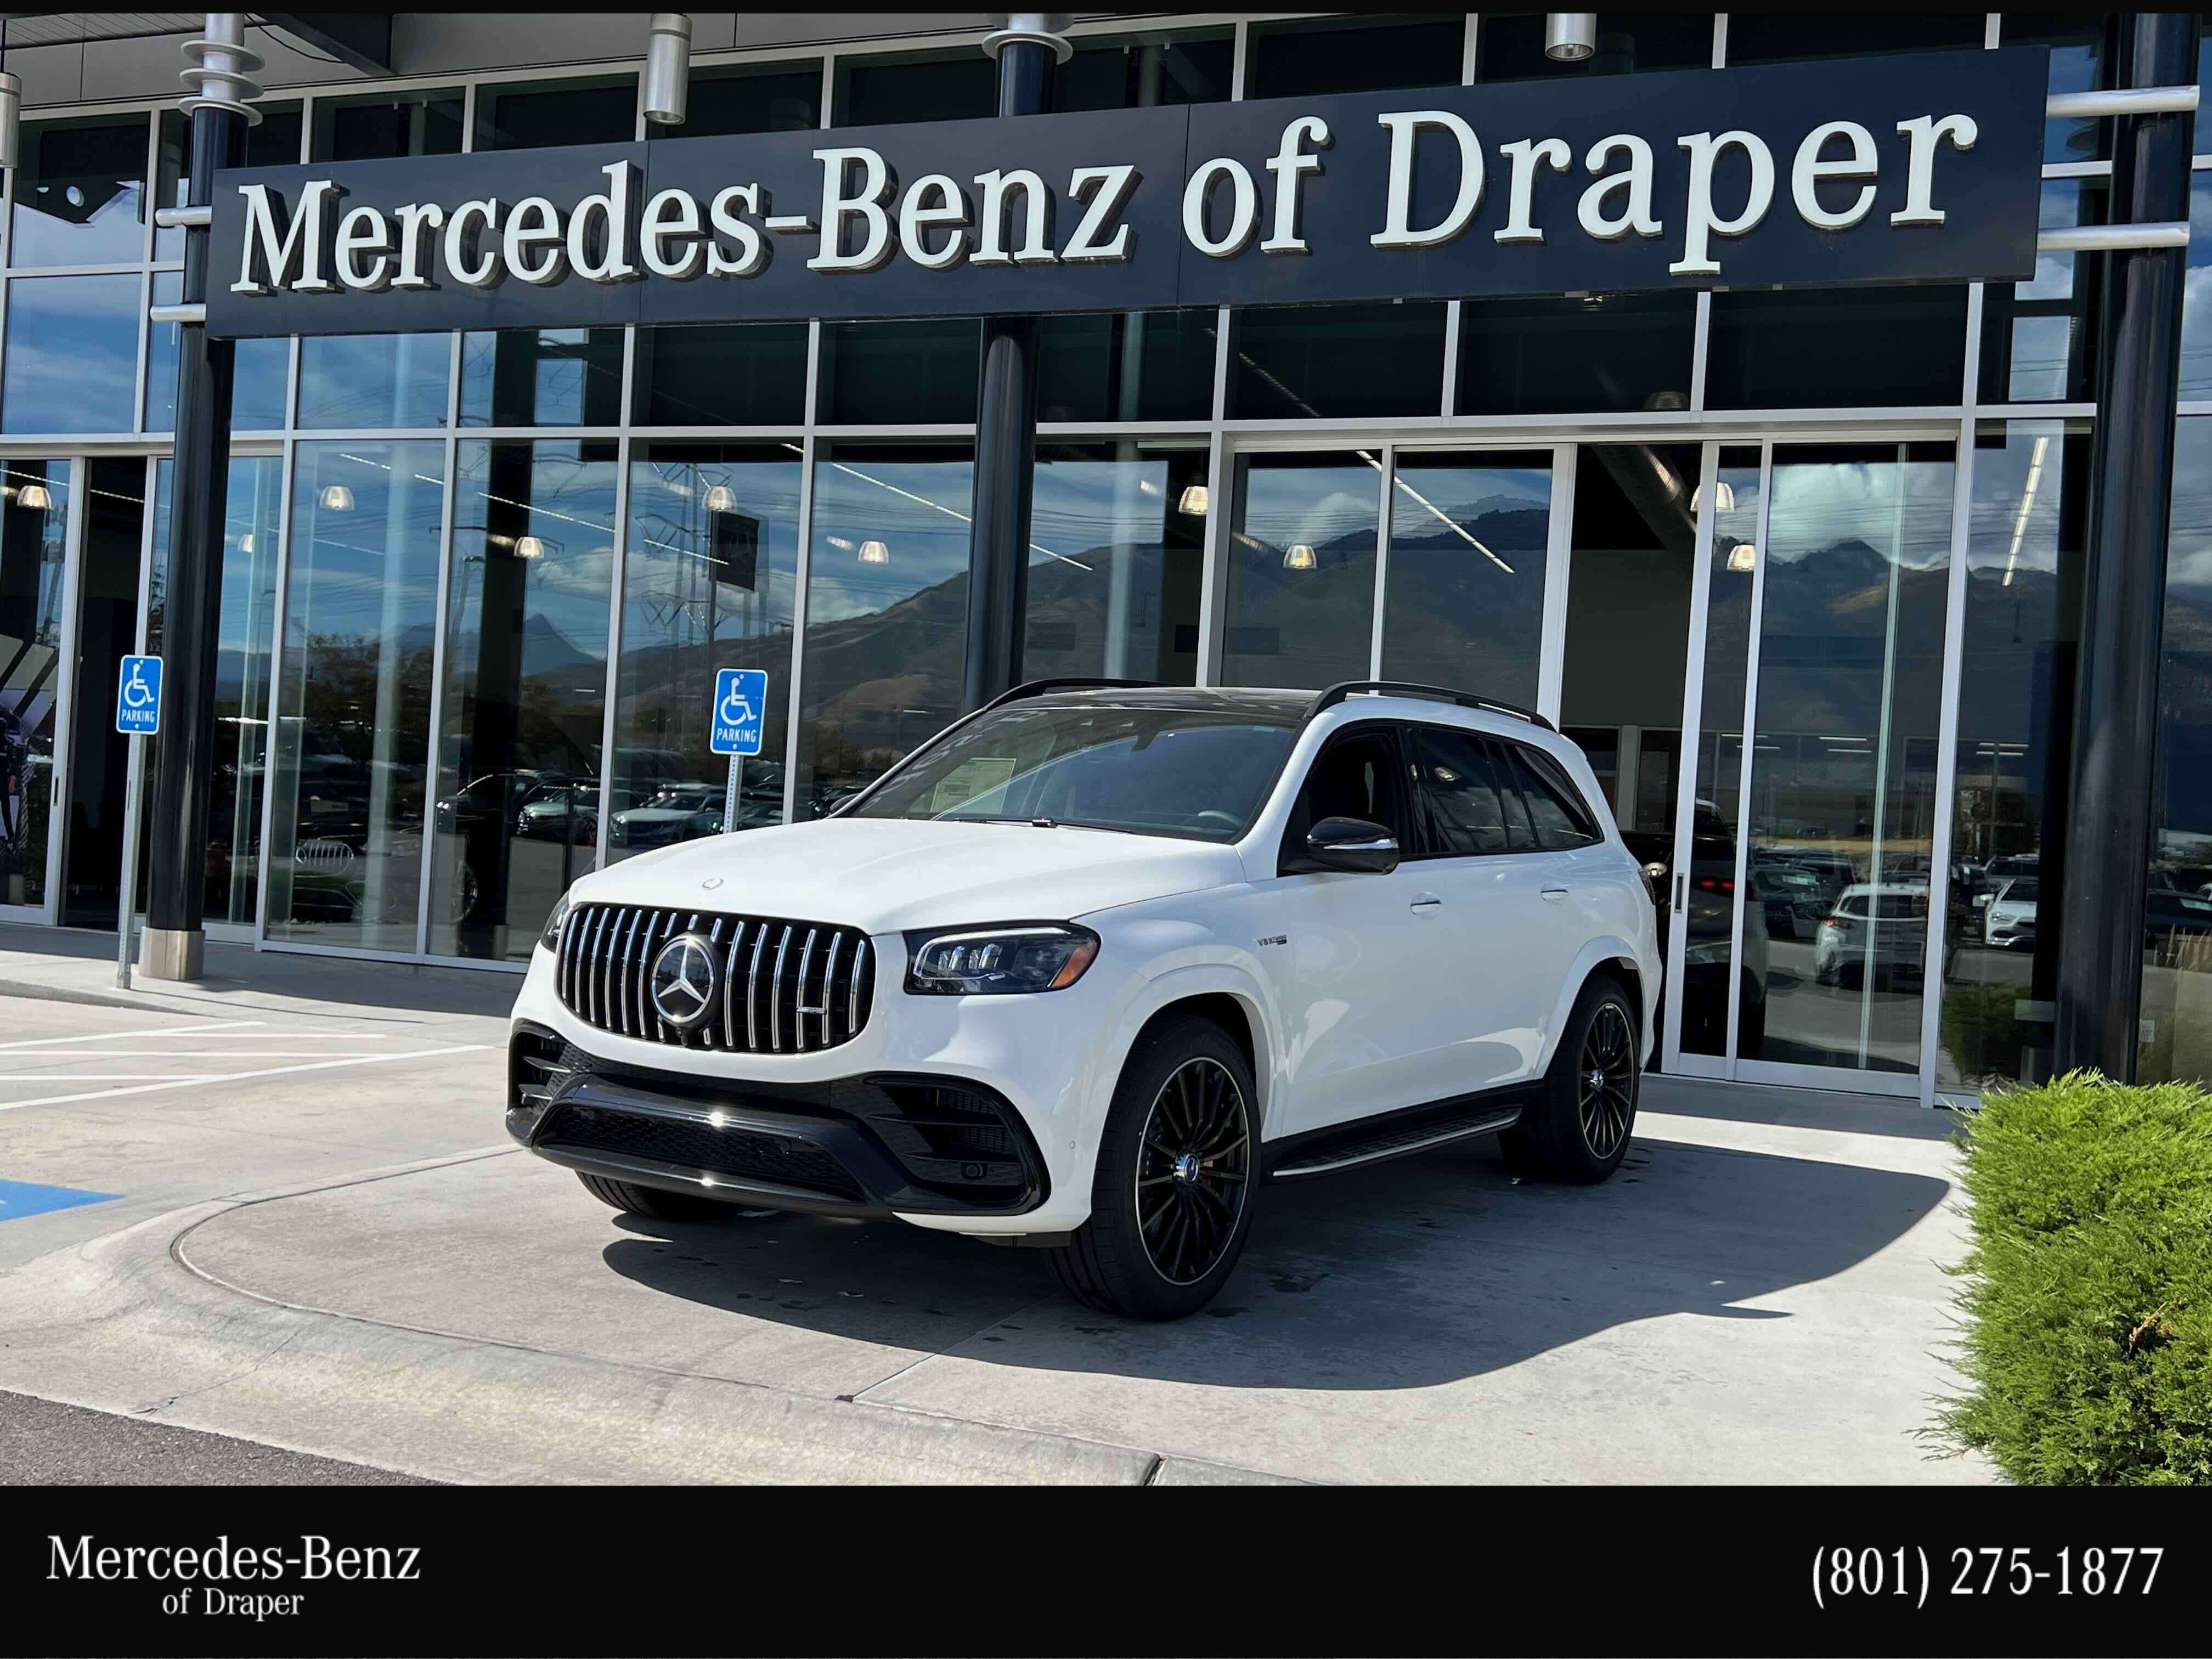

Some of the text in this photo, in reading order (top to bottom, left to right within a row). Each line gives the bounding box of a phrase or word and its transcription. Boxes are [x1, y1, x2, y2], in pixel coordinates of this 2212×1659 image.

[230, 110, 1978, 292] Mercedes-Benz of Draper
[121, 709, 155, 723] PARKING
[716, 727, 757, 743] PARKING
